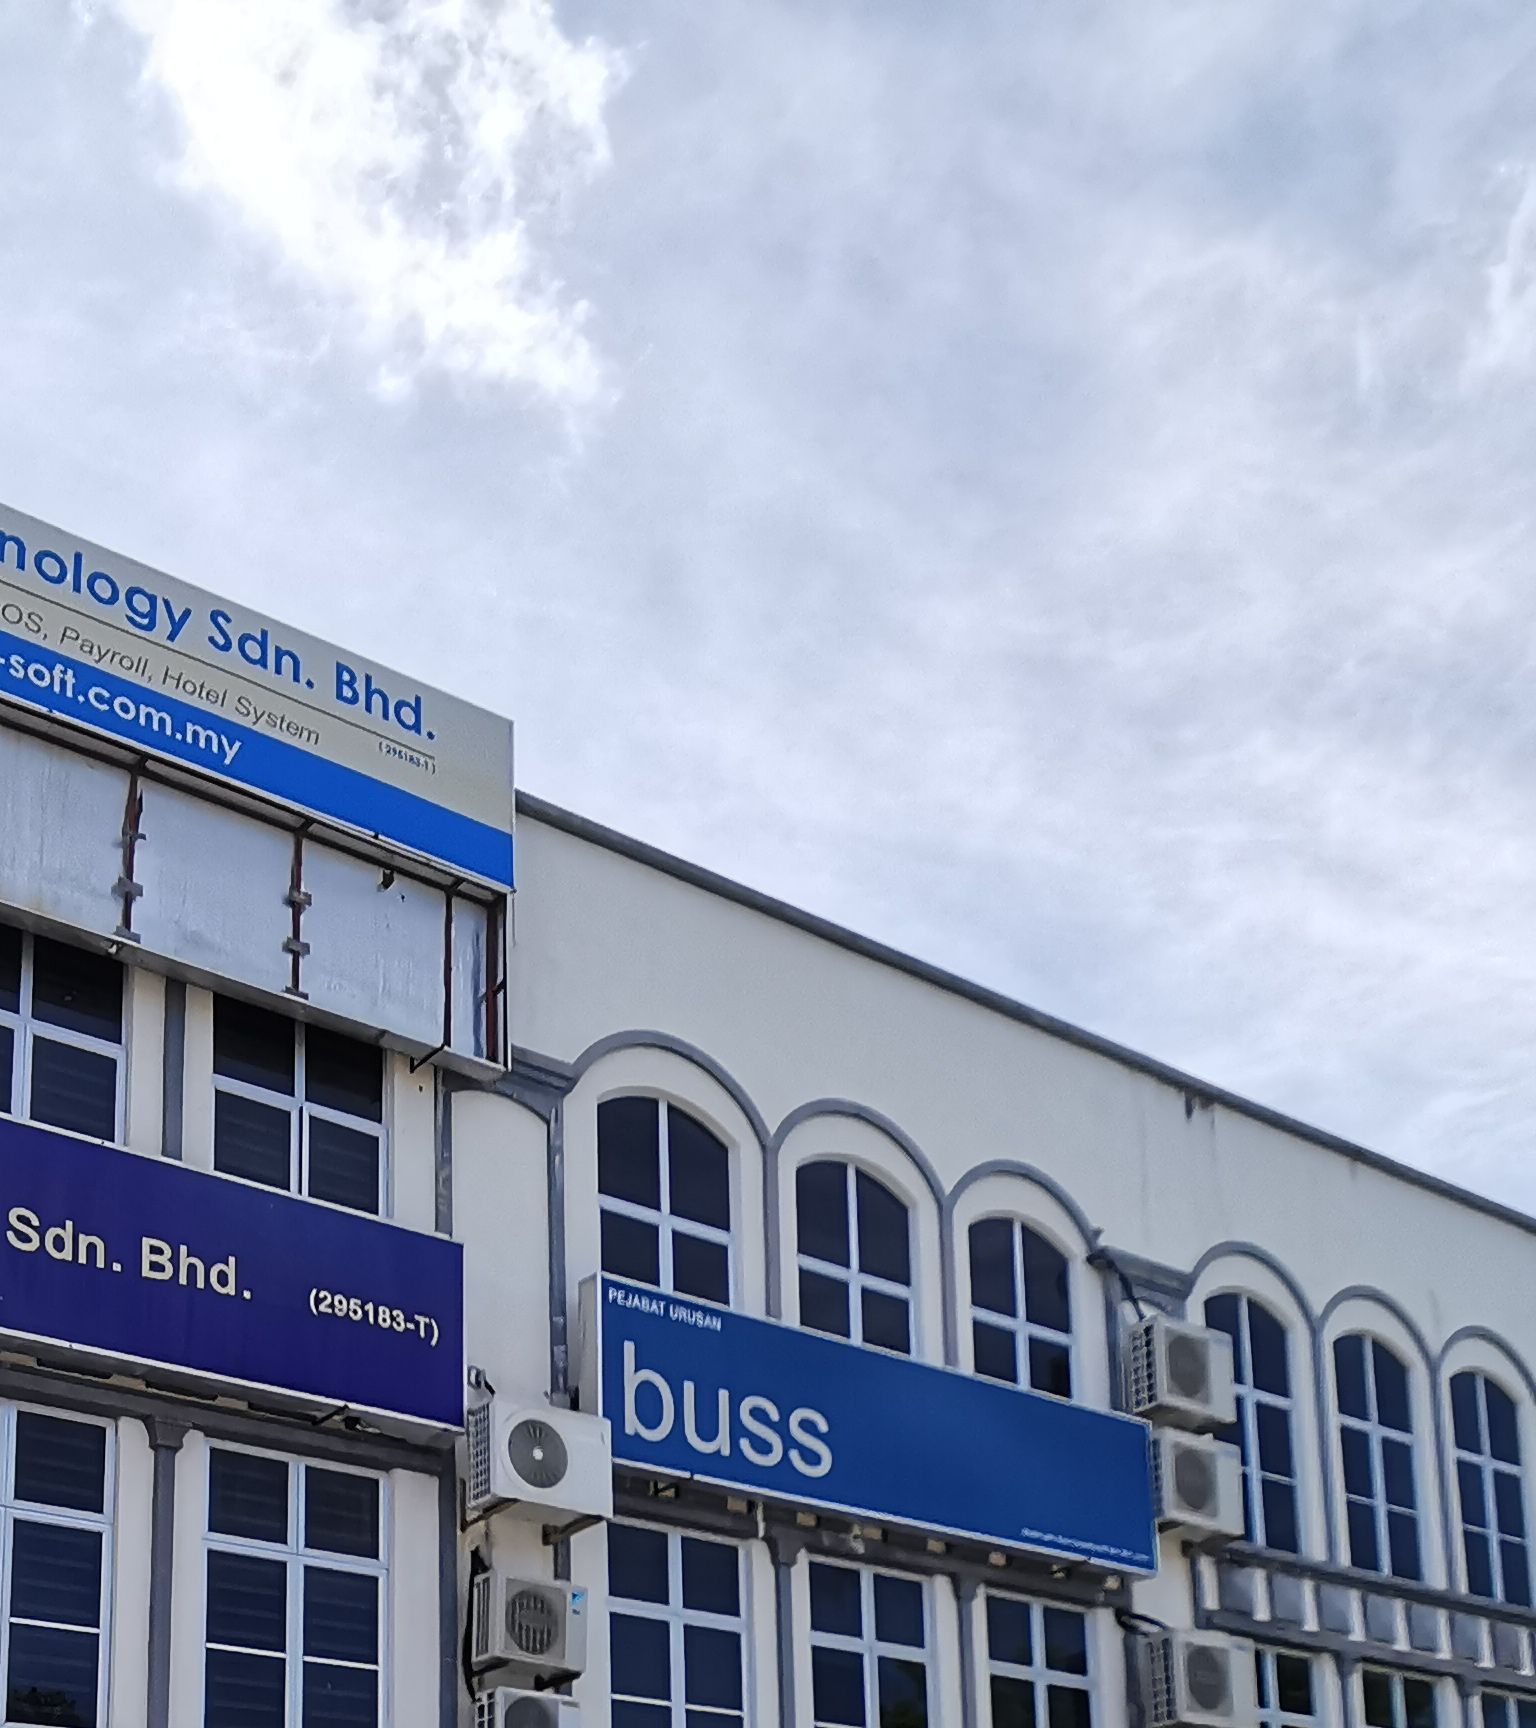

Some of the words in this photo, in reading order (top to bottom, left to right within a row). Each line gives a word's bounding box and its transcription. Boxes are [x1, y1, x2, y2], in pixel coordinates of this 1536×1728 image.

[59, 624, 152, 684] Payroll,
[161, 664, 227, 709] Hotel
[233, 694, 321, 747] System
[207, 608, 314, 690] Sdn.
[335, 660, 437, 741] Bhd.
[5, 1206, 122, 1273] Sdn.
[140, 1235, 252, 1300] Bhd.
[309, 1287, 440, 1347] (295183-T)
[608, 1286, 666, 1317] PEJABAT
[669, 1303, 722, 1332] URUSAN
[622, 1340, 834, 1478] buss
